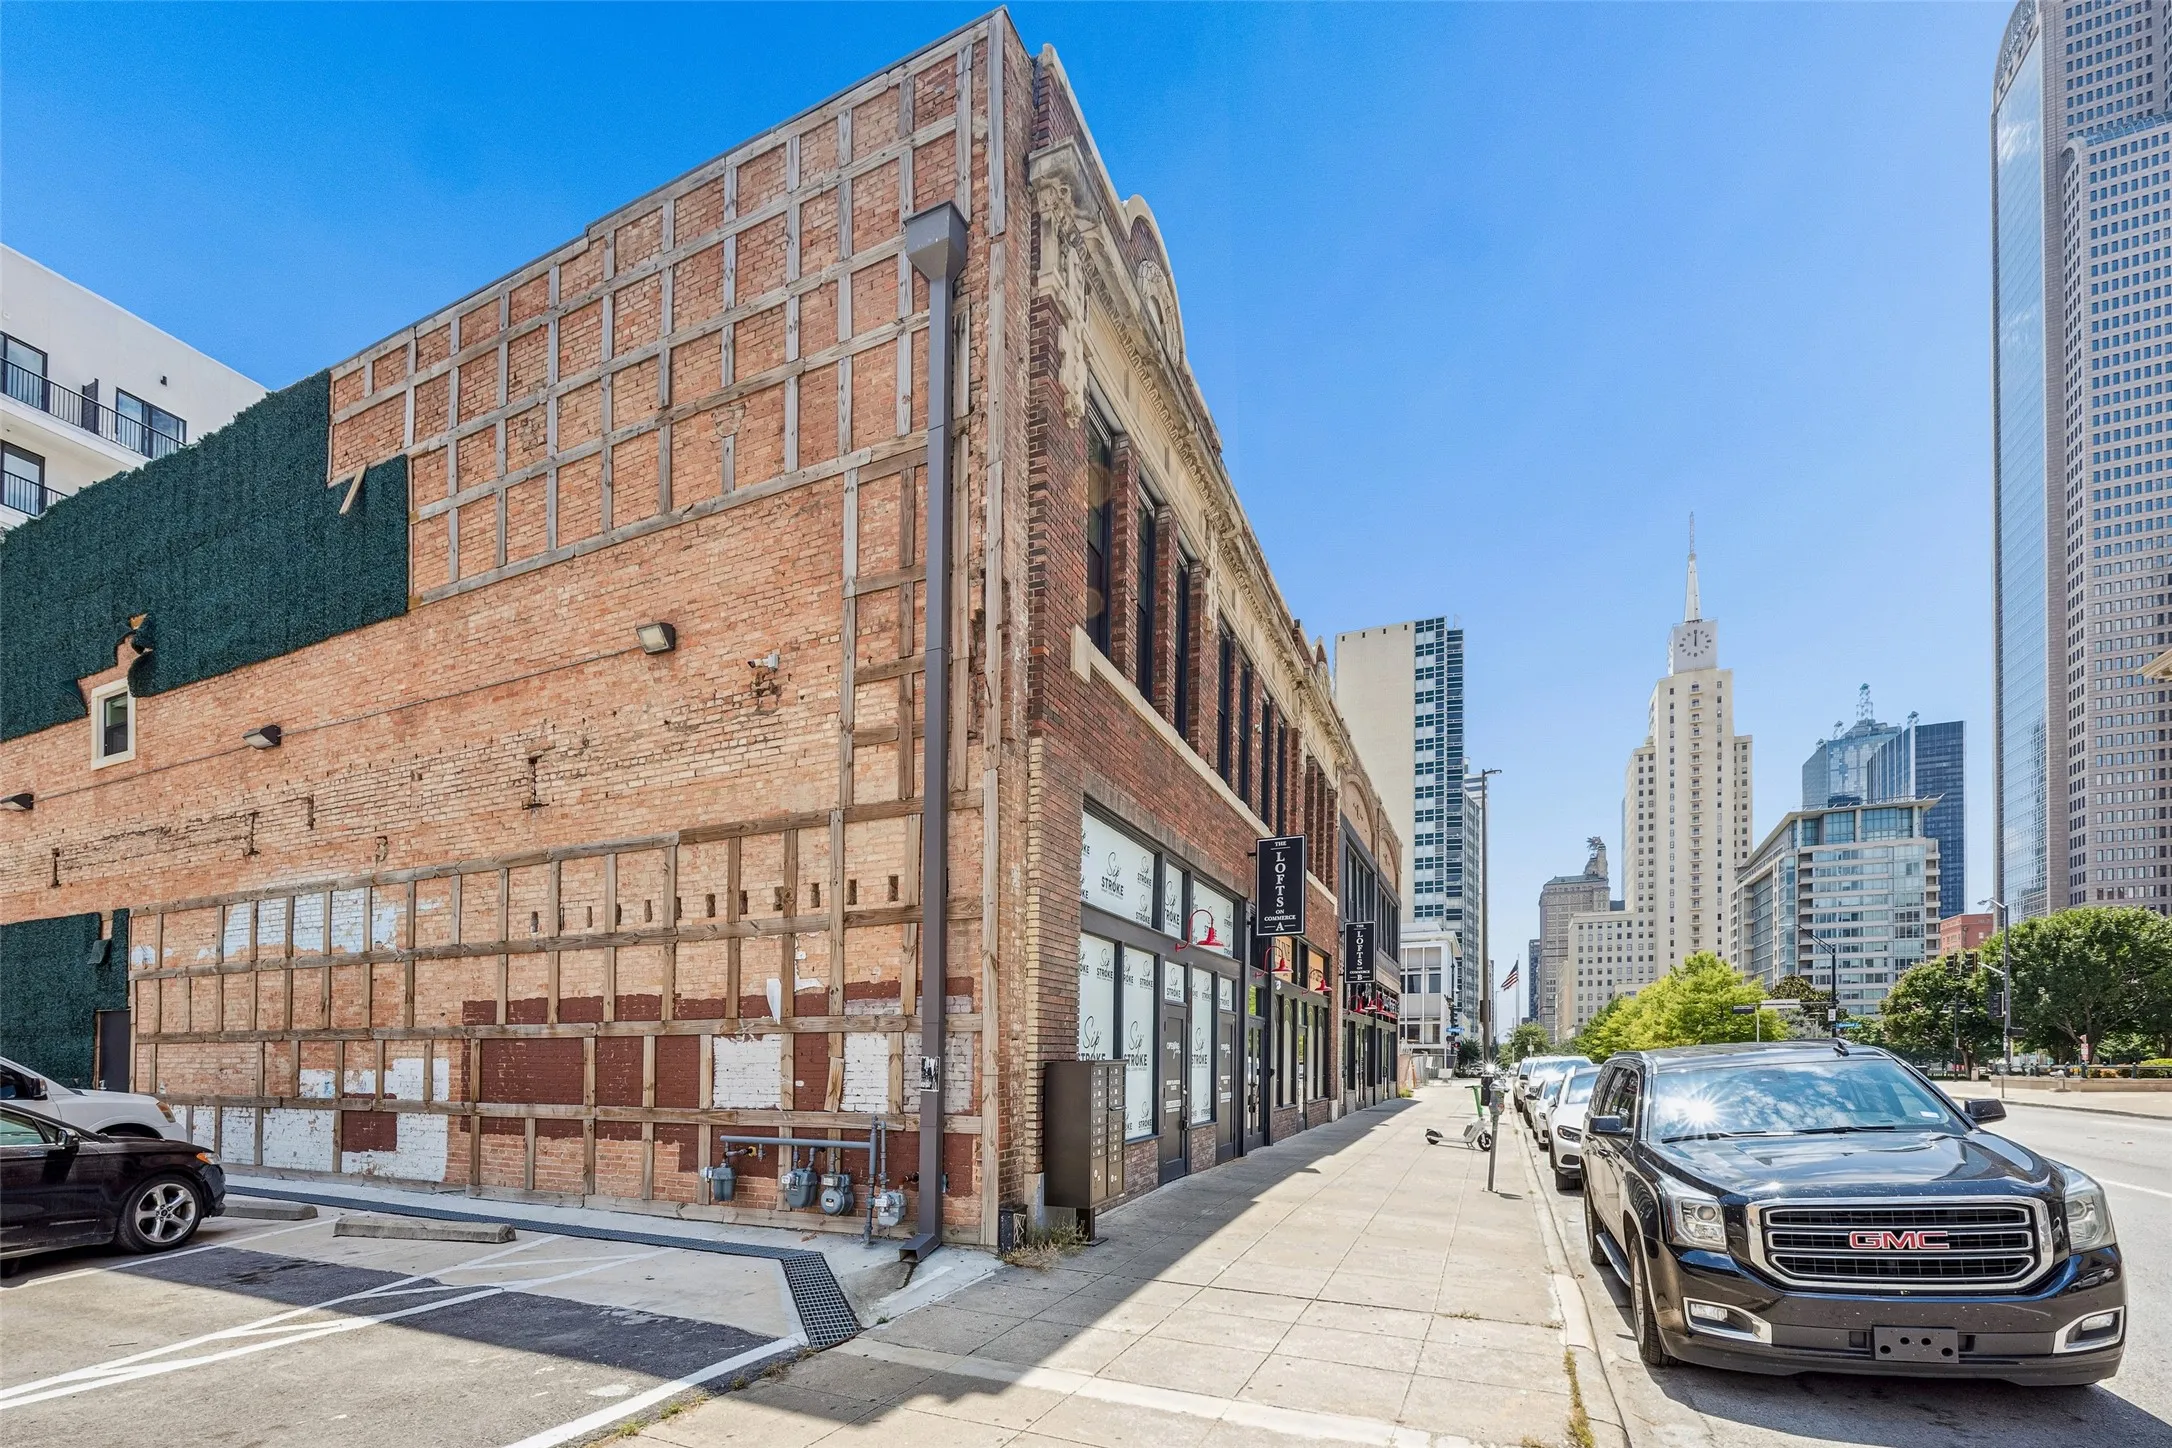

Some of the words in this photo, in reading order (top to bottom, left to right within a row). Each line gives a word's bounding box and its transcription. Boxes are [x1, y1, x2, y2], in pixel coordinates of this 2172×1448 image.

[1137, 873, 1152, 887] STROKE
[1275, 851, 1286, 908] LOFTS
[1101, 876, 1124, 897] STROKE
[1136, 911, 1151, 925] STROKE
[1264, 914, 1296, 922] COMMERCE
[1275, 922, 1285, 931] A
[1356, 930, 1364, 966] LOFTS
[1096, 967, 1113, 980] STROKE
[1140, 978, 1154, 988] STROKE
[1166, 987, 1181, 999] STROKE
[1138, 1119, 1152, 1129] STROKE
[1849, 1230, 1950, 1250] GMC
